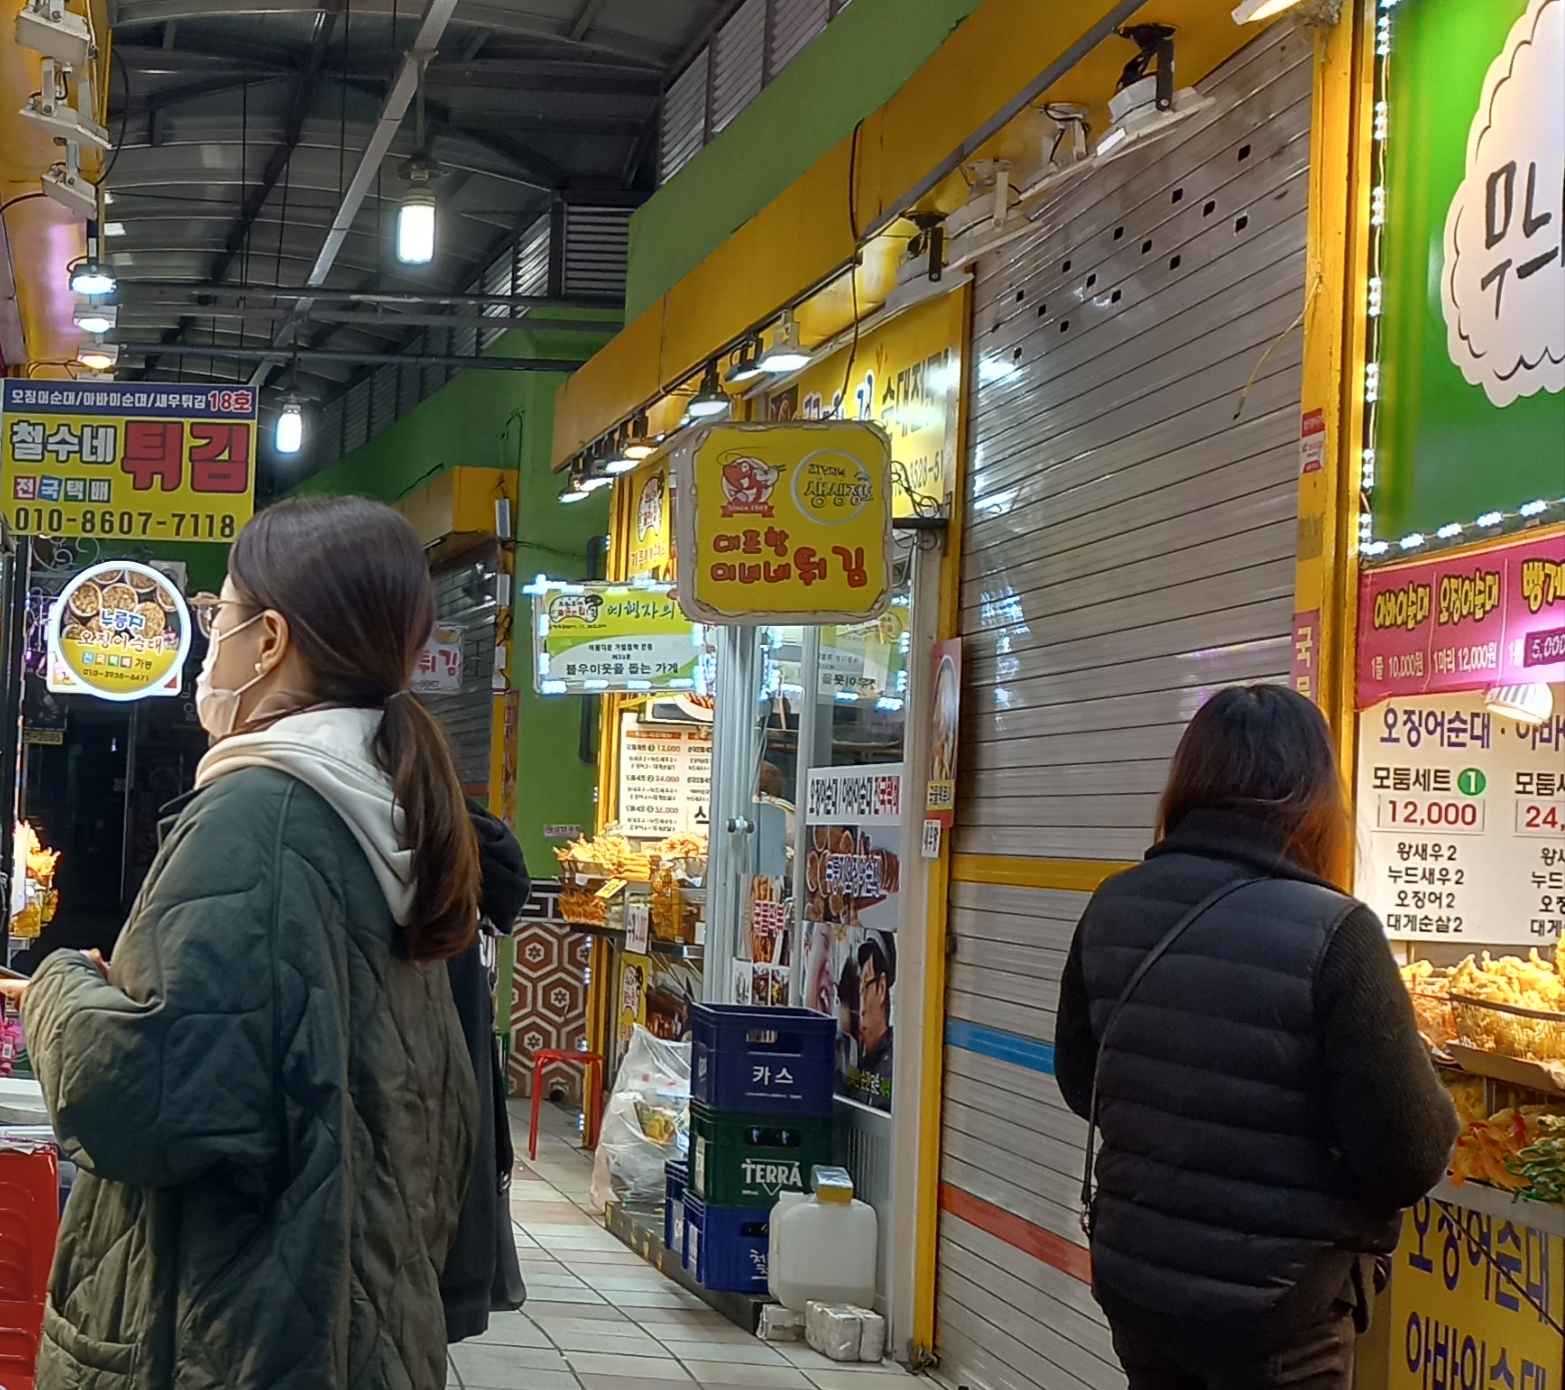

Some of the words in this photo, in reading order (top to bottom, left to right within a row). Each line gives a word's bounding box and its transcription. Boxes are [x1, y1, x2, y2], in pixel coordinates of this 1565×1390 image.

[208, 390, 252, 413] 18호
[11, 420, 117, 465] 철수네
[121, 421, 250, 494] 튀김
[15, 476, 111, 503] 전국택배
[15, 507, 235, 538] 010-8607-7118
[713, 526, 790, 557] 대포항
[1374, 582, 1431, 631] 아바이순대
[1439, 569, 1500, 625] 오징어순대
[77, 631, 164, 654] 오징어순대
[1380, 707, 1491, 749] 오징어순대
[1372, 767, 1451, 792] 모둠세트
[1389, 800, 1477, 827] 12,000
[752, 1066, 793, 1086] 카스
[741, 1161, 803, 1187] TERRA
